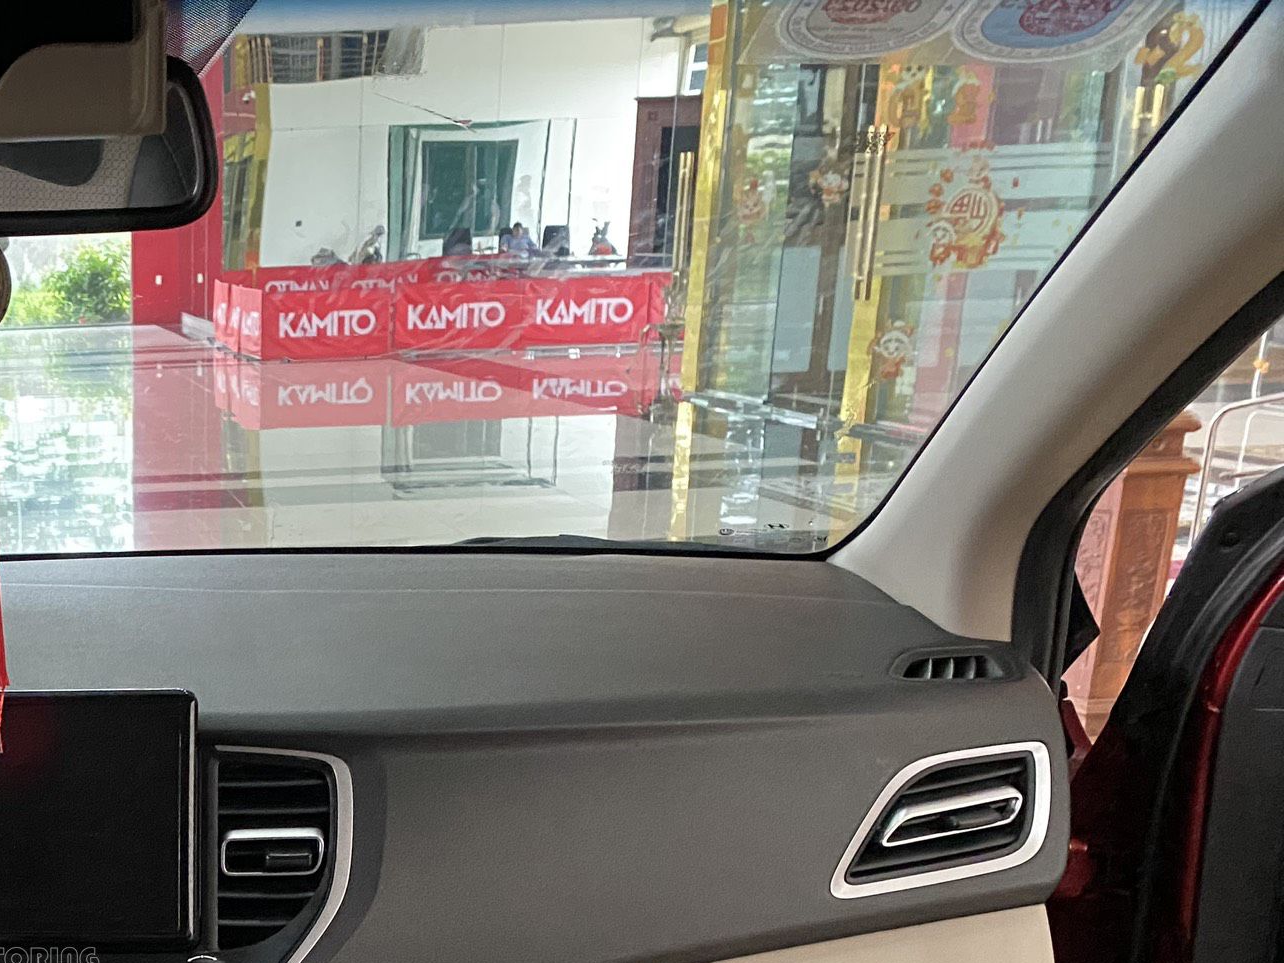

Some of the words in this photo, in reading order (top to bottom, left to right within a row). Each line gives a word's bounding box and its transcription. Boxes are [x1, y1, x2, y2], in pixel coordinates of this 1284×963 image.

[278, 309, 376, 338] KAMITO
[407, 301, 506, 330] KAMITO
[535, 297, 634, 325] KAMITO
